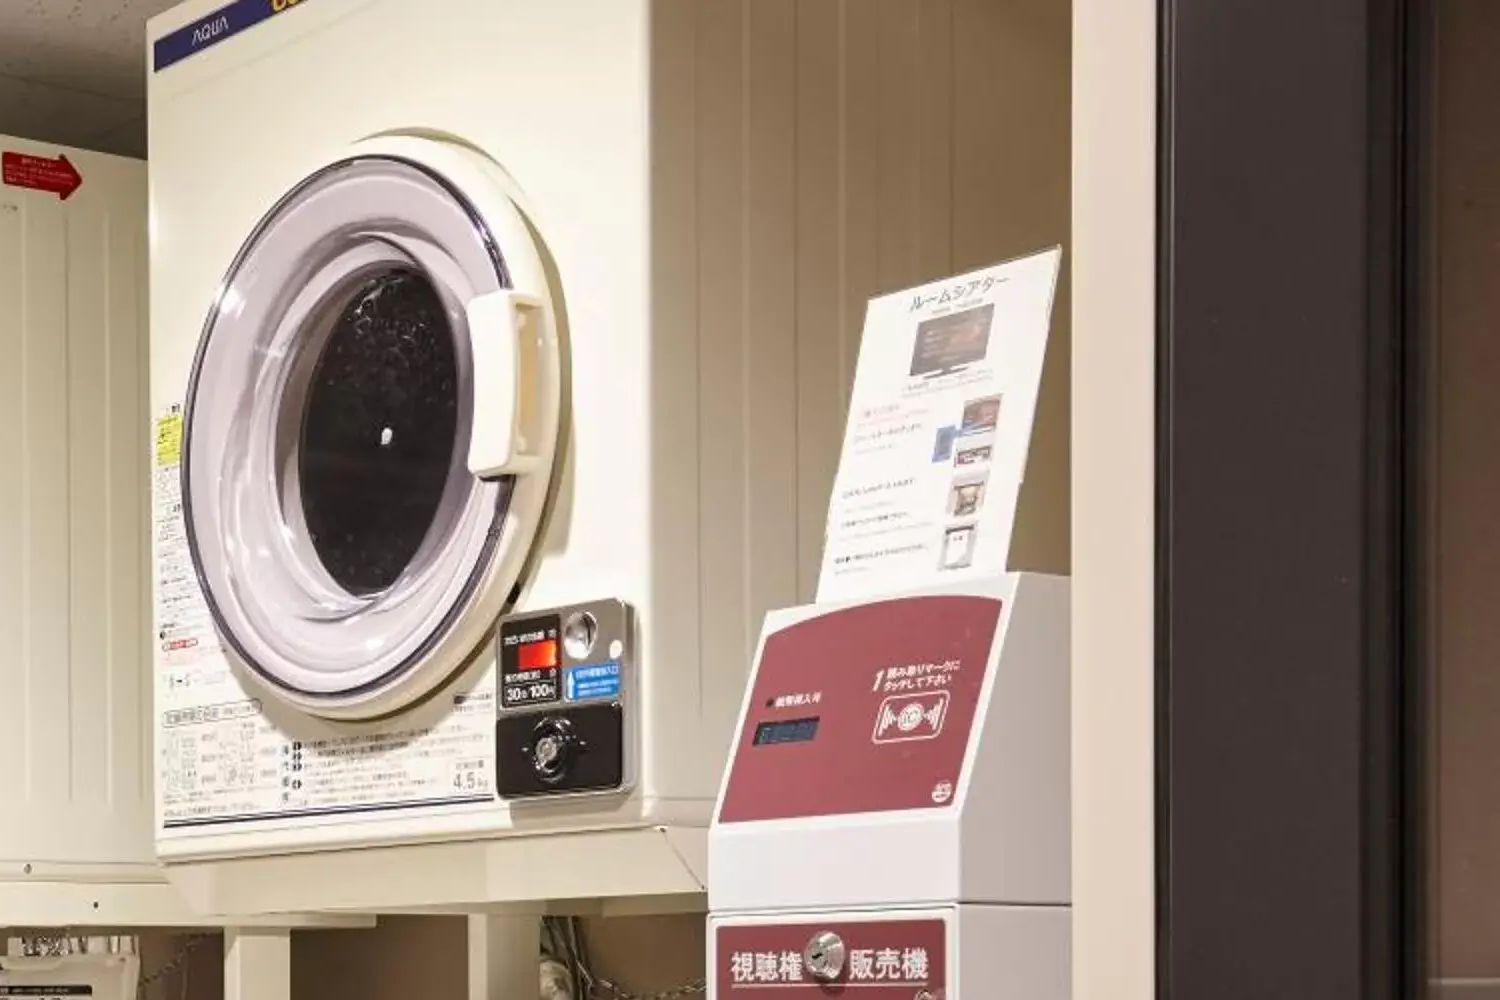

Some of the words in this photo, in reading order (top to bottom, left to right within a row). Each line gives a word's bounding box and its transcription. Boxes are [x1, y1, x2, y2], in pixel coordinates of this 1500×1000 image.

[909, 276, 1010, 312] ルームシアター
[872, 669, 885, 692] 1
[731, 951, 804, 982] 視聴権
[849, 947, 930, 980] 販売機
